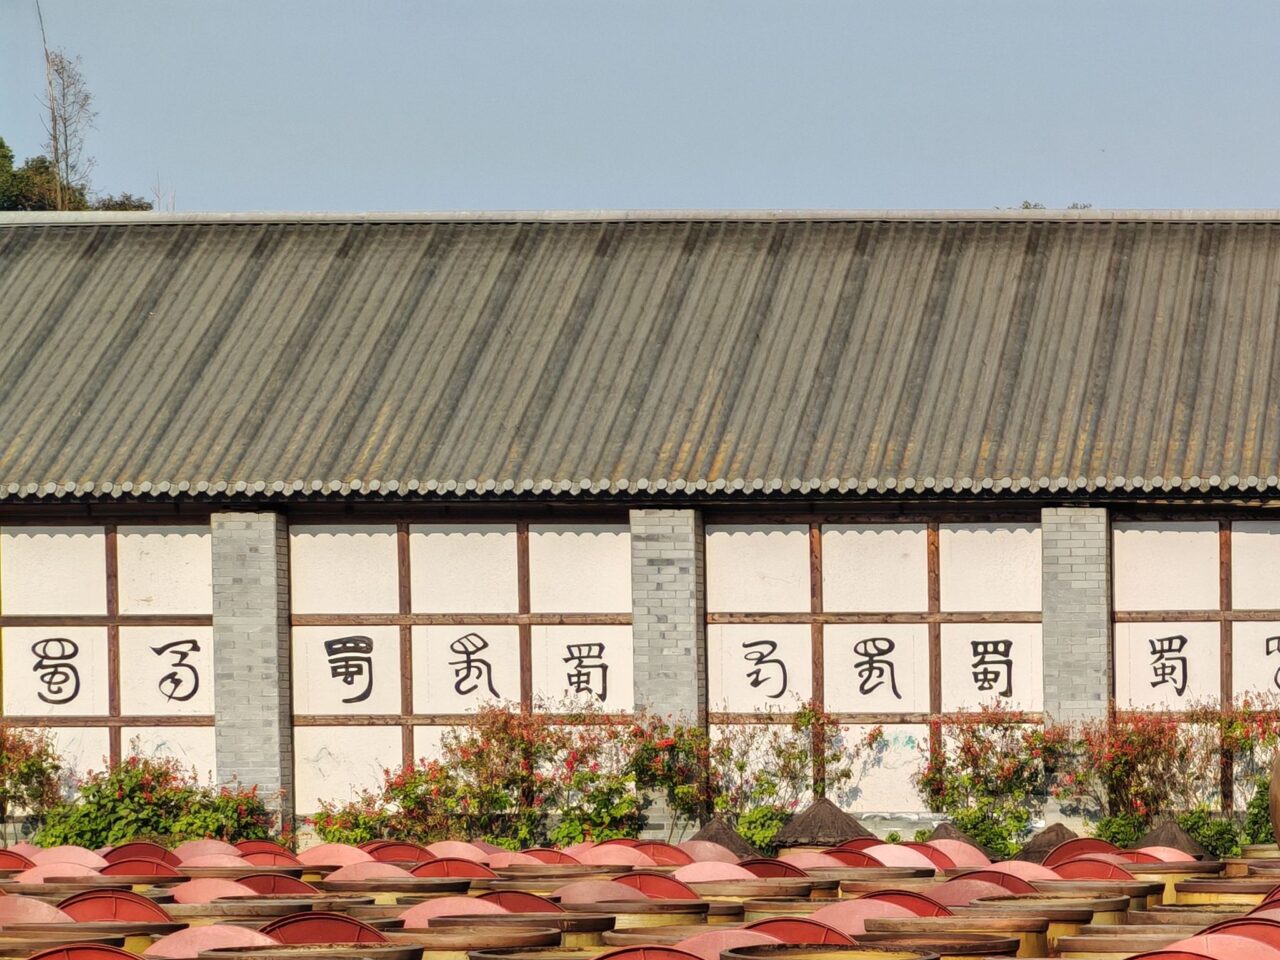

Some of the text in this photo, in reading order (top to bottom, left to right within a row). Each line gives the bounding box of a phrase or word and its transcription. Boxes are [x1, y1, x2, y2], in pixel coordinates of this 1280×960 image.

[564, 643, 608, 701] 蜀
[971, 640, 1012, 697] 蜀
[1149, 636, 1187, 696] 蜀
